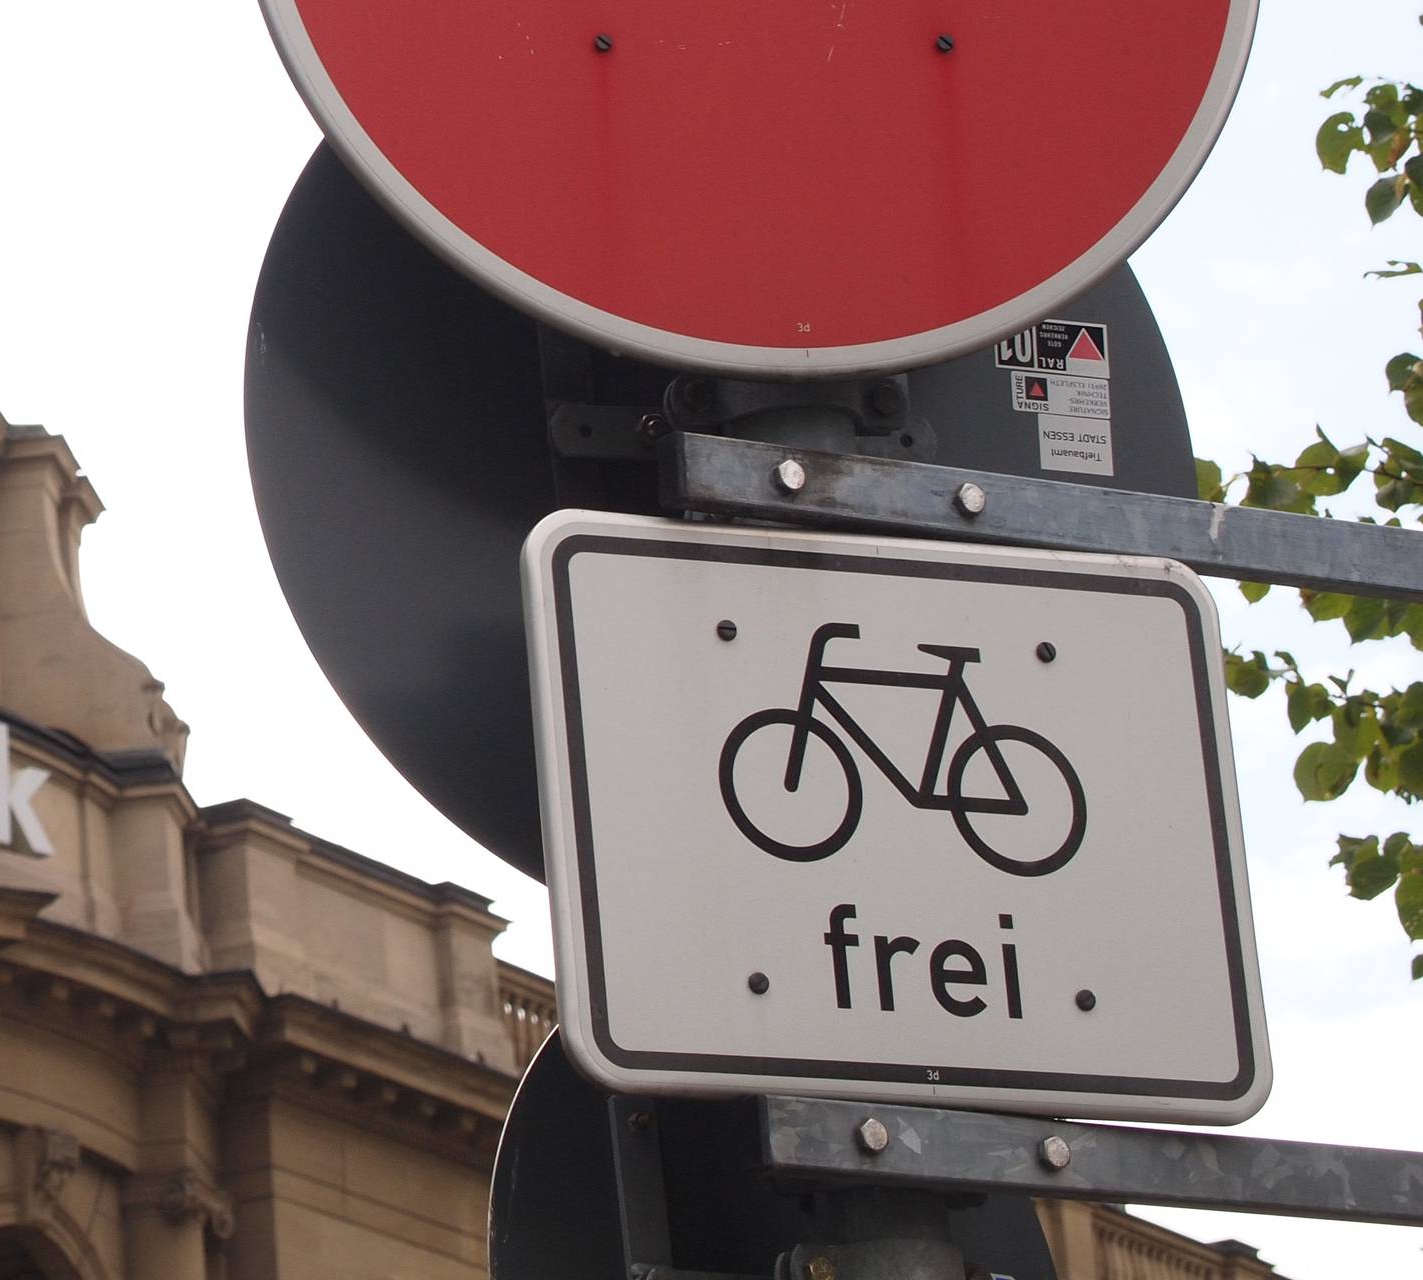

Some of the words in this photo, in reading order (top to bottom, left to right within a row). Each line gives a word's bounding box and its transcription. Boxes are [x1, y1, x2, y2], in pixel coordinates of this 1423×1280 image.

[1039, 357, 1064, 369] RAL
[1043, 430, 1074, 442] ESSEN
[1078, 433, 1107, 444] STADT
[1050, 449, 1102, 462] Tiefbauamt
[823, 903, 1023, 1019] frei
